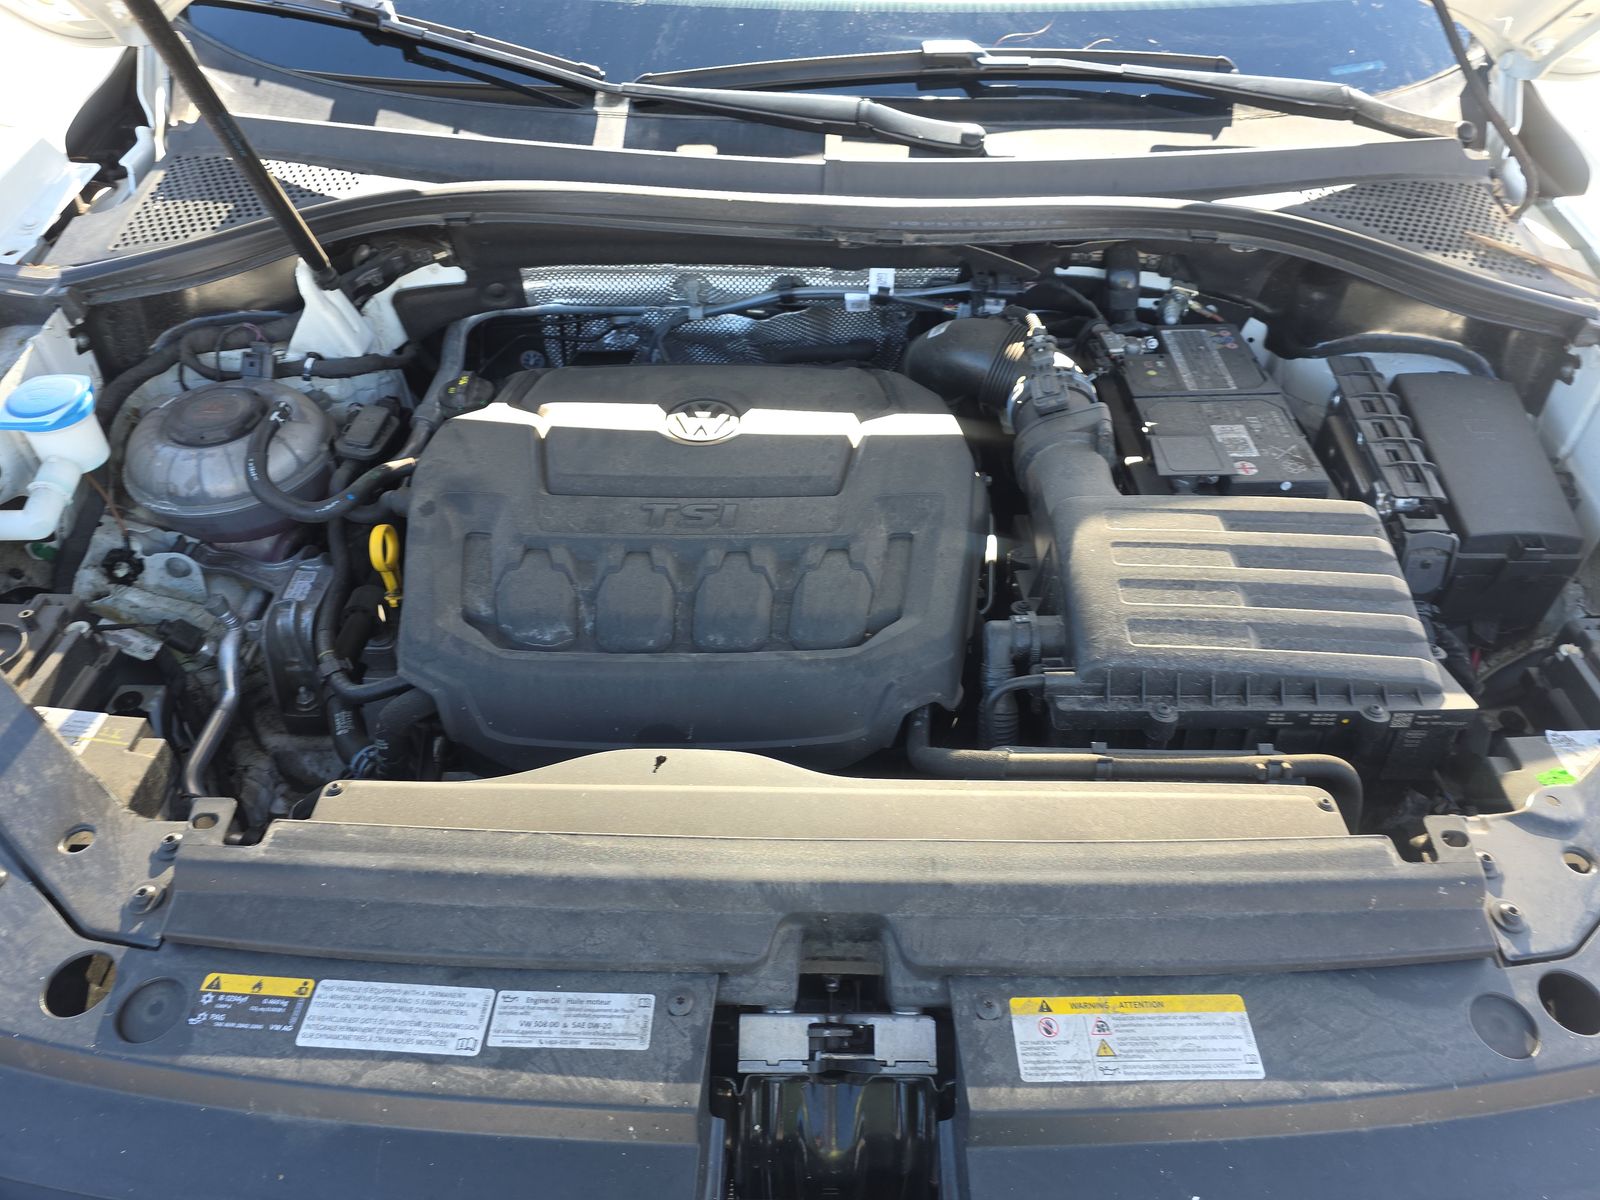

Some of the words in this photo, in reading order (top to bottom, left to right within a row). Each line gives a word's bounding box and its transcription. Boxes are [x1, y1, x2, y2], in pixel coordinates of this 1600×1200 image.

[641, 502, 739, 529] TSI
[586, 998, 612, 1006] moteur
[1069, 1001, 1109, 1010] WARNING
[1118, 1000, 1165, 1009] ATTENTION
